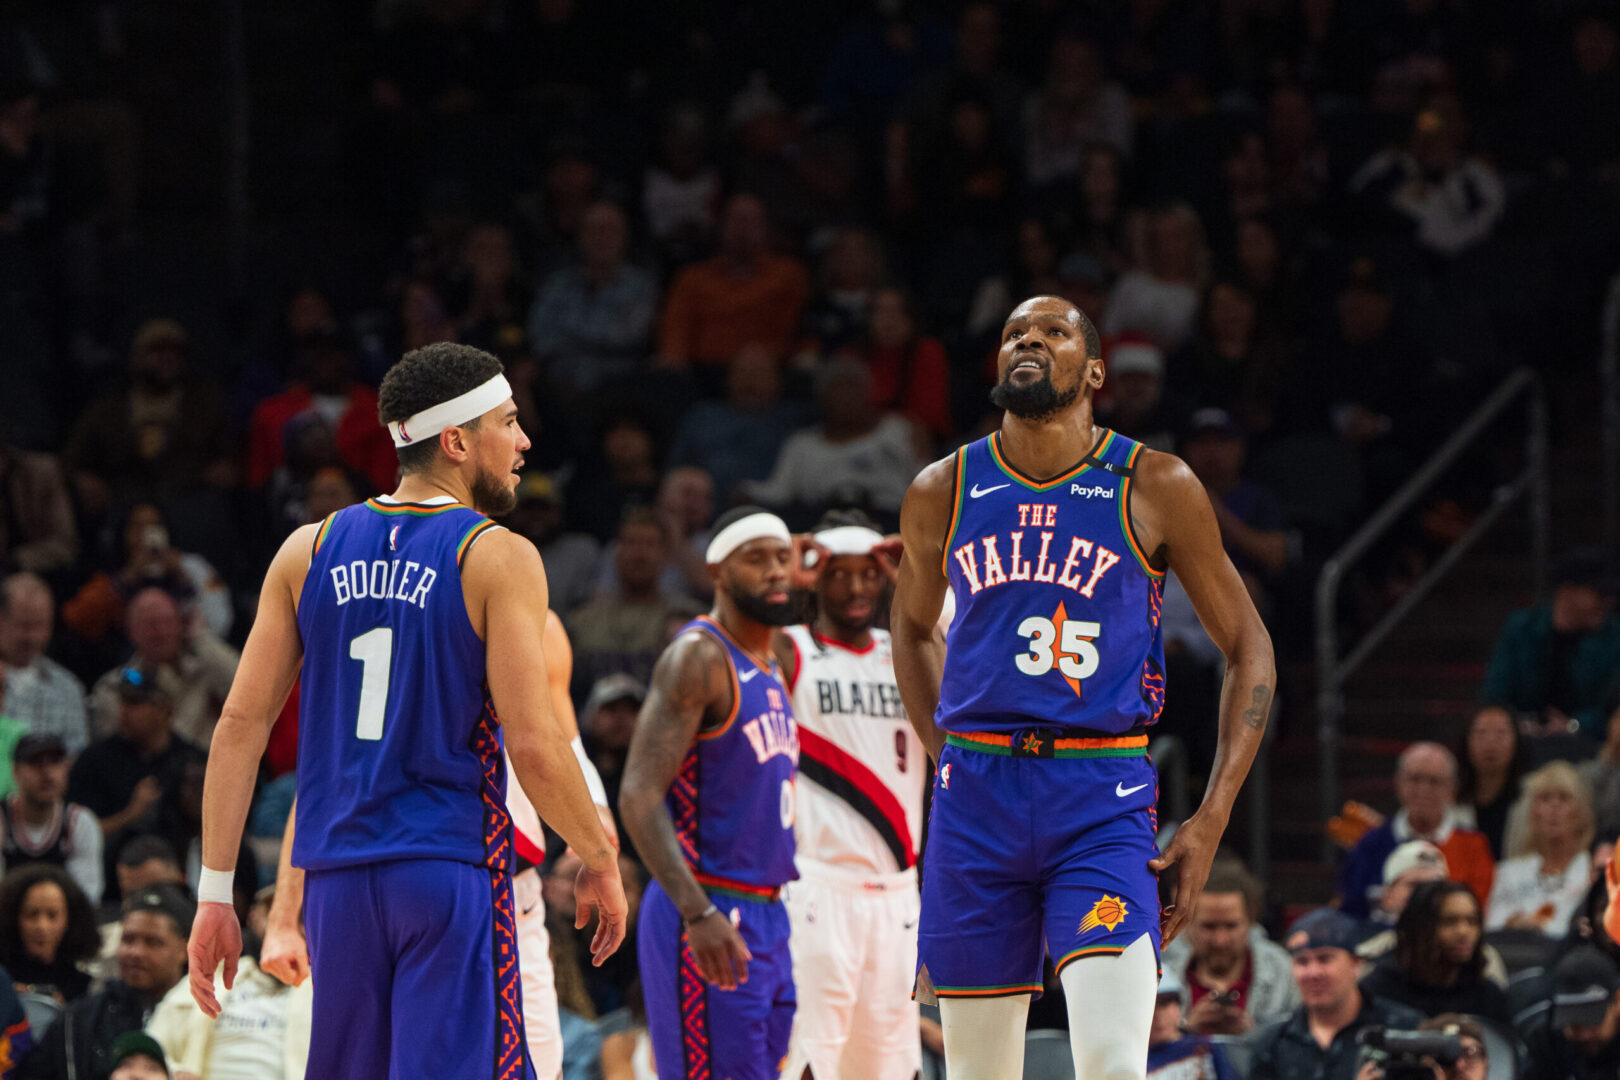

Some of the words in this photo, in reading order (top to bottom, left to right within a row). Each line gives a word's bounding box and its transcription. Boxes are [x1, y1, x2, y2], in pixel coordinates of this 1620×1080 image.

[1070, 483, 1114, 499] PayPal
[1018, 504, 1057, 527] THE
[954, 531, 1121, 599] VALLEY
[1015, 616, 1100, 679] 35
[349, 627, 393, 741] 1
[816, 679, 908, 719] BLAZER
[895, 729, 906, 773] 9
